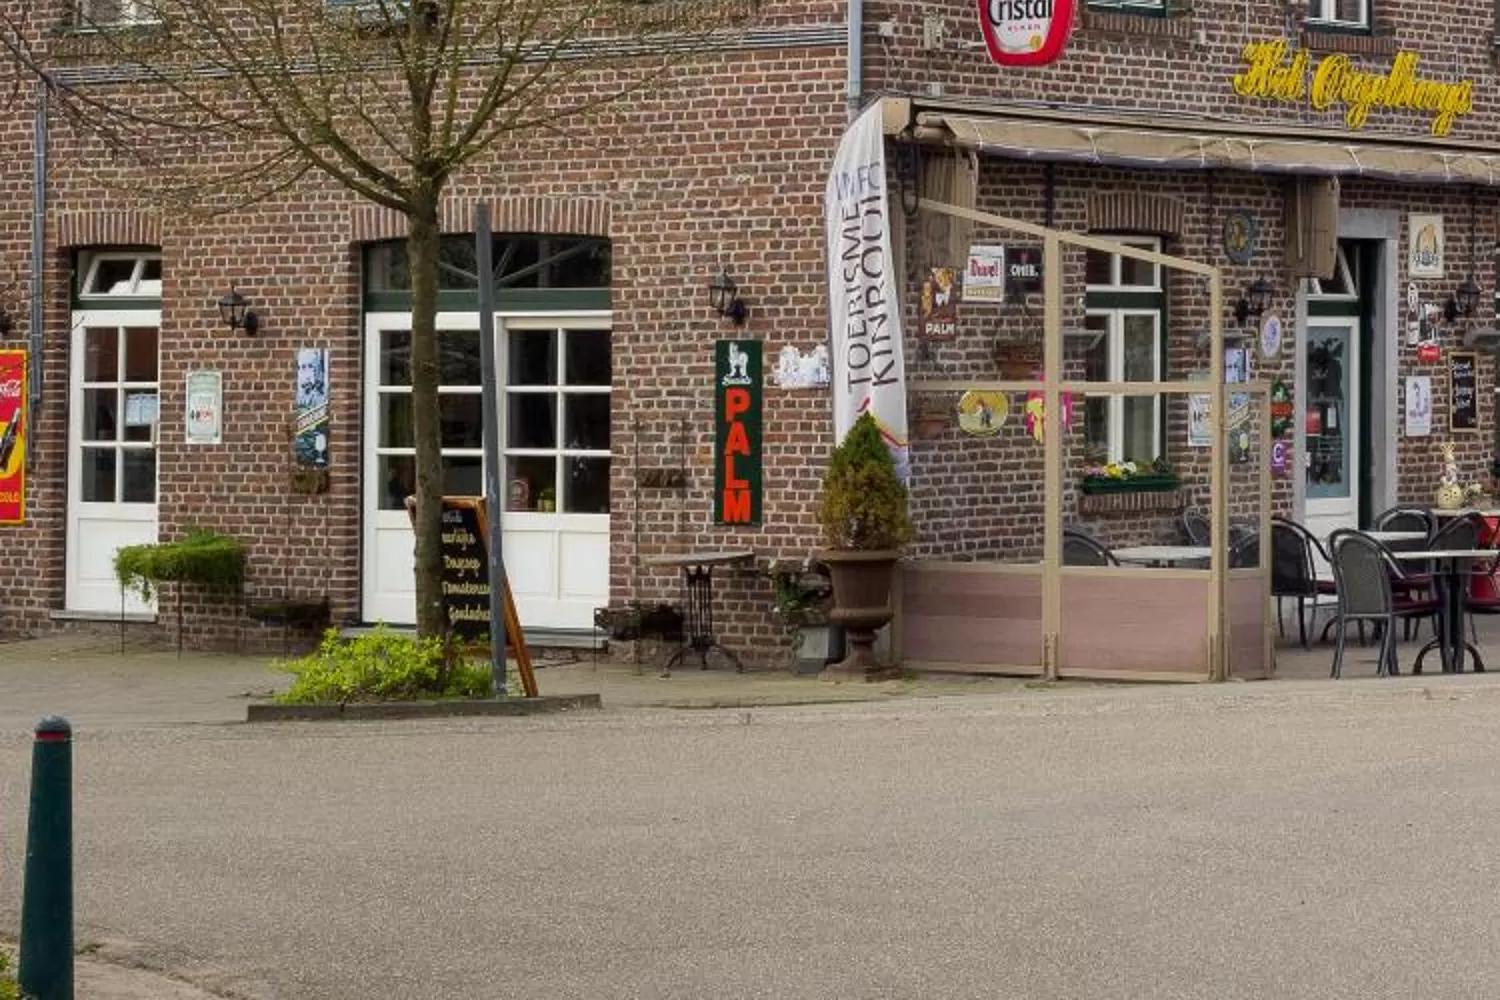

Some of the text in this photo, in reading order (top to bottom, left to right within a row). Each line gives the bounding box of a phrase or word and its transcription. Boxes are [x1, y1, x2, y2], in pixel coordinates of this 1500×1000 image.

[1233, 39, 1308, 98] Het
[971, 258, 999, 277] Duvel
[842, 202, 872, 394] TOERISME
[925, 323, 955, 335] PALM
[722, 387, 750, 523] PALM
